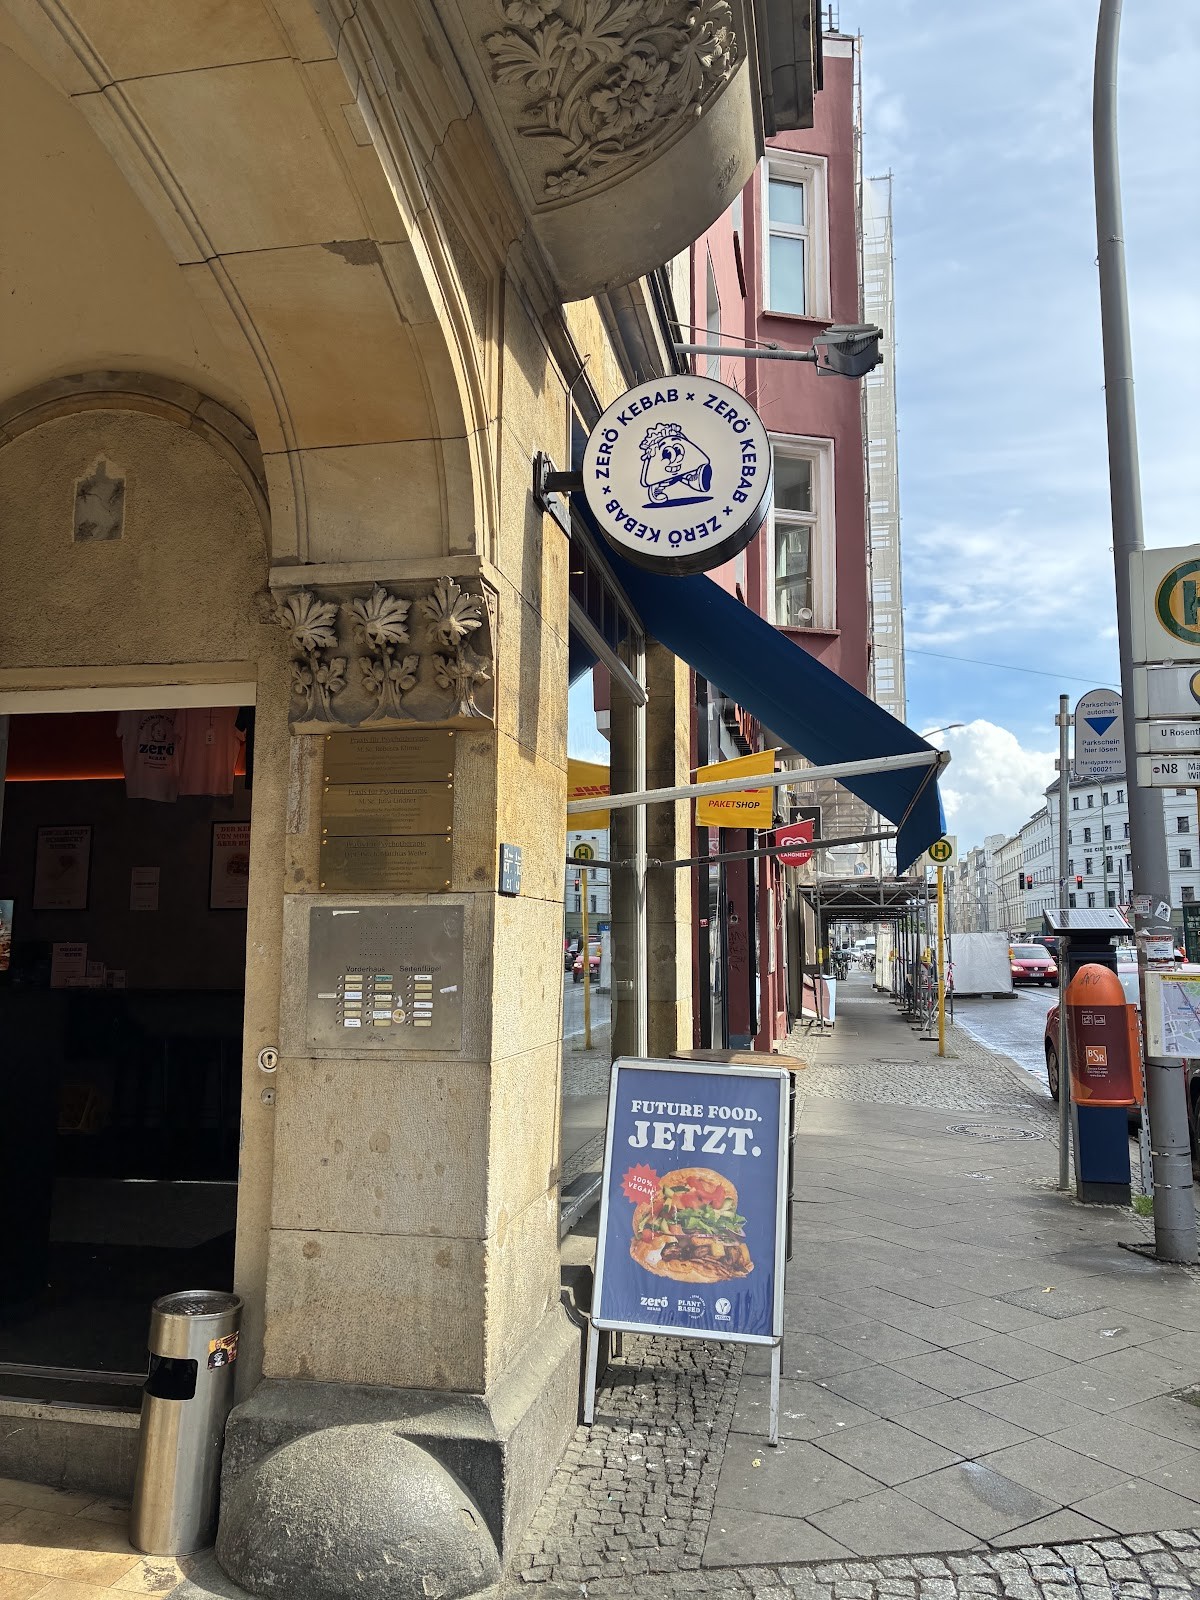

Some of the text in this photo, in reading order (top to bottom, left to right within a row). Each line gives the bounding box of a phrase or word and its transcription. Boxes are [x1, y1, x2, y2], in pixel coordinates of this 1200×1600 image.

[596, 388, 679, 480] ZERÖ KEBAB
[702, 393, 757, 504] ZERÖ KEBAB
[605, 498, 722, 549] ZERÖ KEBAB
[1080, 700, 1121, 708] Parkschein-
[1086, 708, 1115, 716] automat
[1170, 728, 1200, 736] Rosent
[1082, 738, 1120, 746] Parkschein
[138, 742, 175, 756] zerö
[1162, 764, 1178, 774] N8
[708, 800, 760, 809] PAKETSHOP
[1094, 844, 1113, 852] CIRUS
[399, 964, 442, 974] Seitenflügel
[1088, 1049, 1105, 1062] BSR
[631, 1100, 762, 1122] FUTURE FOOD.
[628, 1120, 762, 1157] JETZT.
[632, 1175, 652, 1187] 100%
[640, 1296, 668, 1308] zerö
[678, 1299, 702, 1308] PLANT
[678, 1306, 700, 1314] BASED
